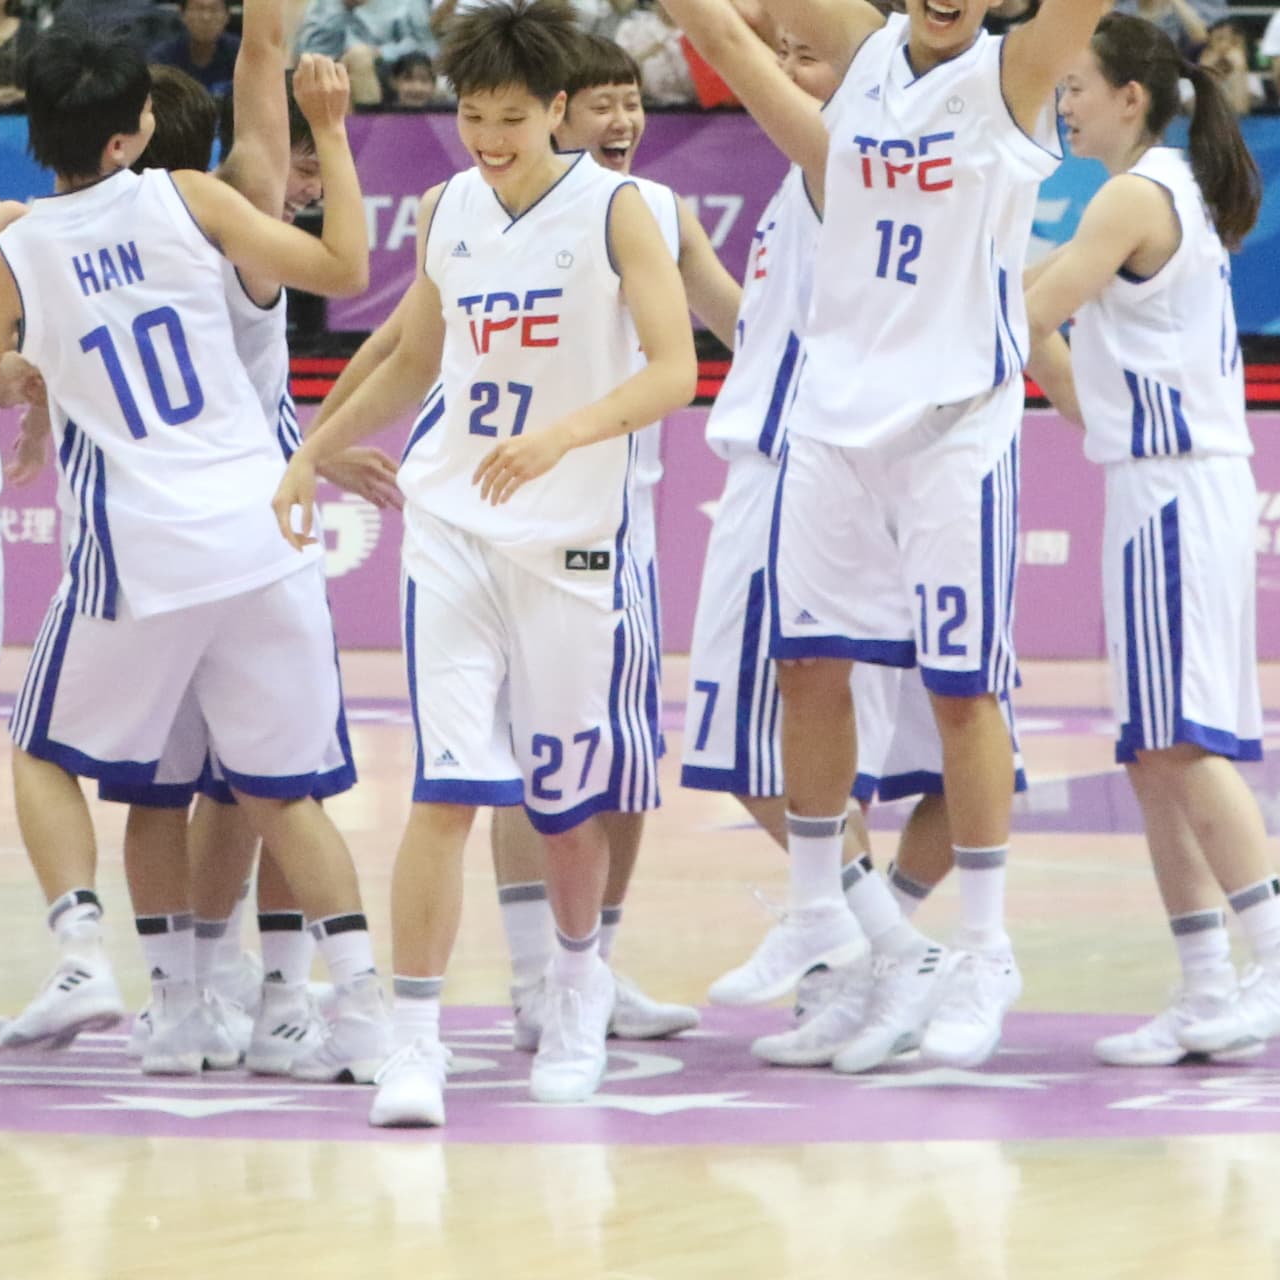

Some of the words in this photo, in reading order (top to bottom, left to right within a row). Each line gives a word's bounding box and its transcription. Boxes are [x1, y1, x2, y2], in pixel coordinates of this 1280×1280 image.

[853, 131, 955, 193] TPE
[72, 239, 145, 296] HAN
[875, 219, 923, 285] 12
[457, 287, 562, 355] TPE
[80, 304, 206, 440] 10
[469, 381, 533, 436] 27
[916, 582, 969, 658] 12
[531, 726, 601, 803] 27
